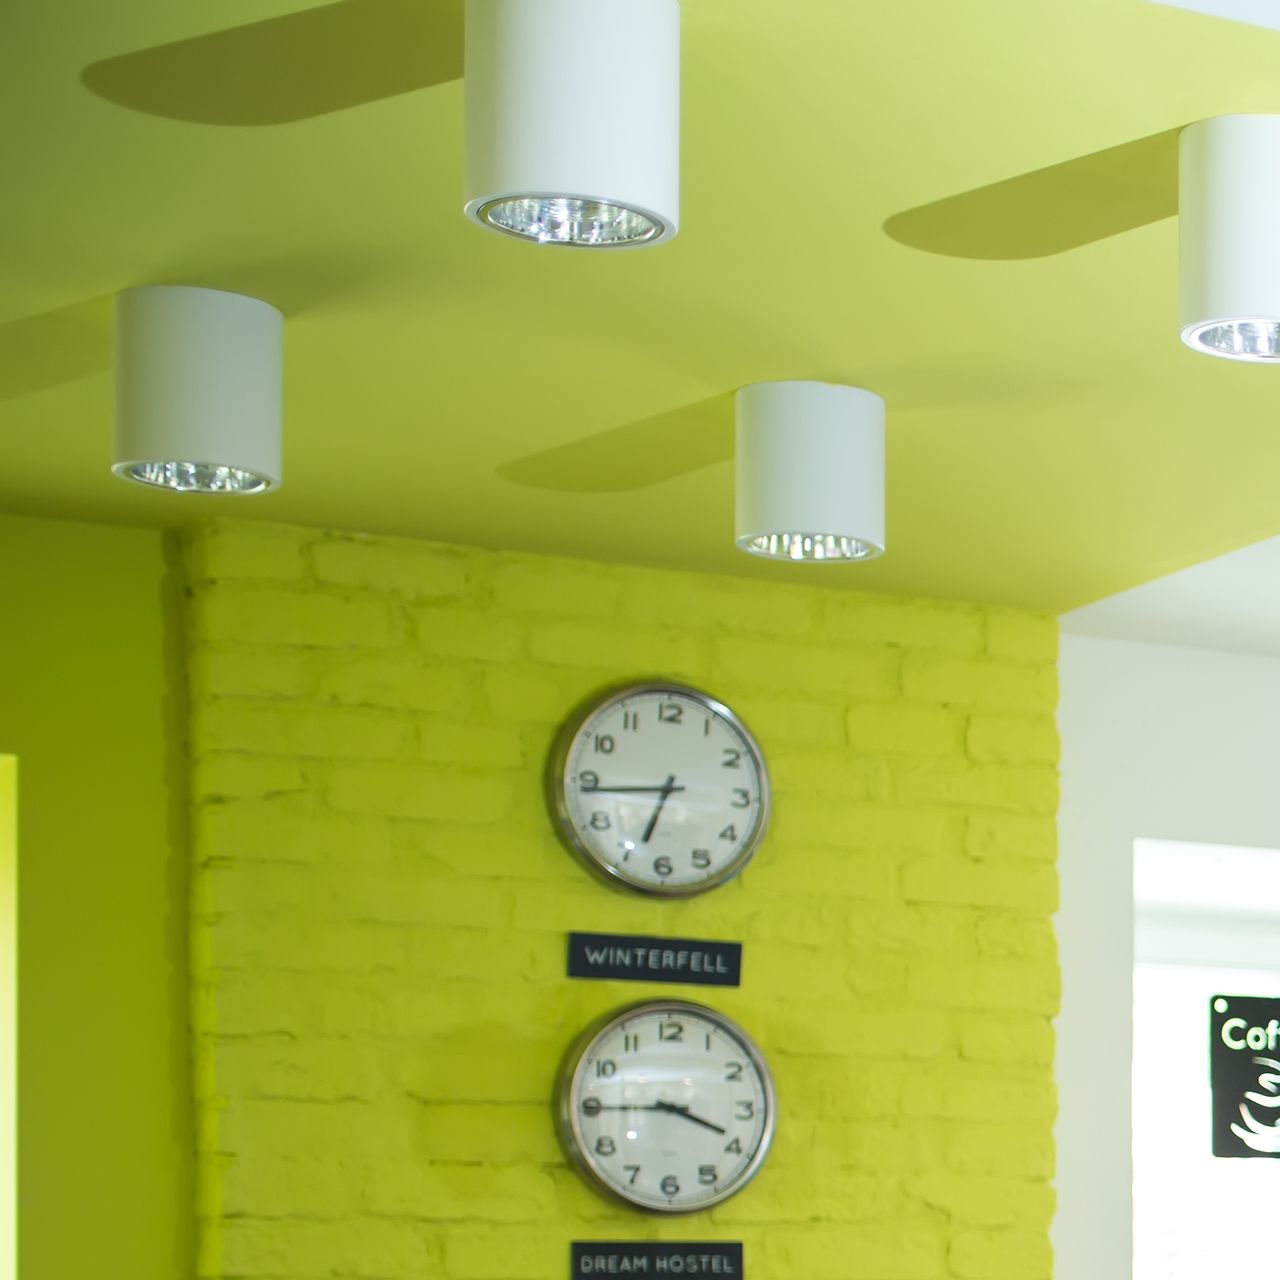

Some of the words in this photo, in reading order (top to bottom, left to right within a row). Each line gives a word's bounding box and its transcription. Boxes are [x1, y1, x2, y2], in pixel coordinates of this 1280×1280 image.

[624, 711, 638, 730] 11
[659, 703, 683, 724] 12
[594, 734, 615, 755] 10
[721, 749, 741, 769] 2
[731, 787, 750, 808] 3
[590, 811, 611, 830] 8
[719, 824, 736, 842] 4
[653, 856, 673, 876] 6
[692, 849, 711, 869] 5
[584, 945, 728, 974] WINTERFELL
[624, 1034, 638, 1052] 11
[658, 1023, 684, 1043] 12
[596, 1060, 617, 1077] 10
[725, 1062, 743, 1081] 2
[735, 1101, 754, 1121] 3
[595, 1136, 616, 1155] 8
[725, 1137, 742, 1155] 4
[623, 1165, 640, 1184] 7
[698, 1165, 717, 1185] 5
[660, 1175, 680, 1195] 6
[580, 1254, 648, 1273] DREAM
[655, 1254, 734, 1273] HOSTEL
